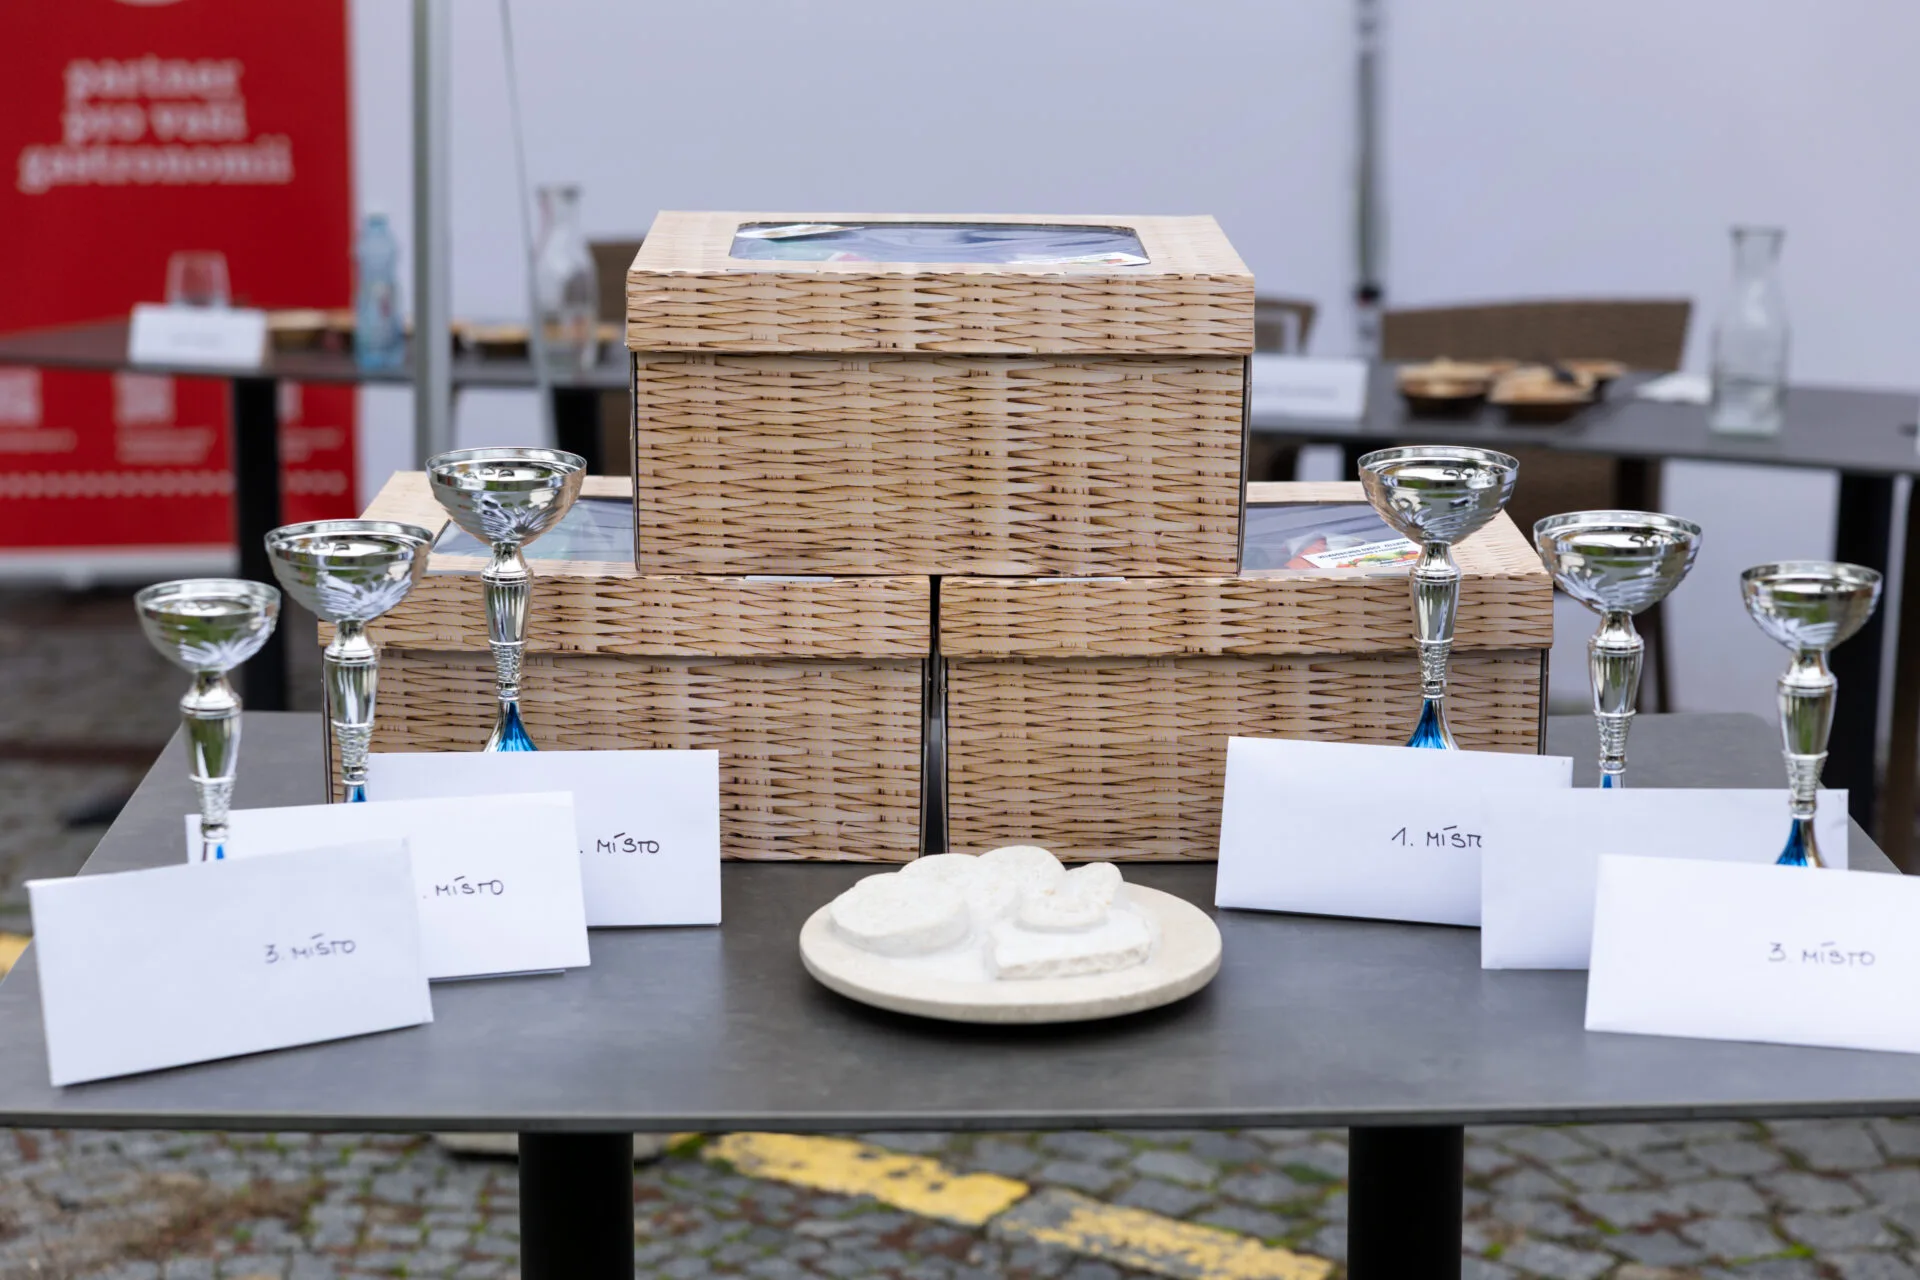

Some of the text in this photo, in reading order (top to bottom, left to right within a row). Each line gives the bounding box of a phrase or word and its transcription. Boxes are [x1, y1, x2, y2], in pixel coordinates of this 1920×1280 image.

[596, 831, 660, 854] MÍSTO
[1391, 826, 1414, 847] 1.
[435, 875, 504, 897] MÍSTO
[264, 932, 357, 964] 3. MÍSTO
[1767, 941, 1876, 967] 3. MÍSTO
